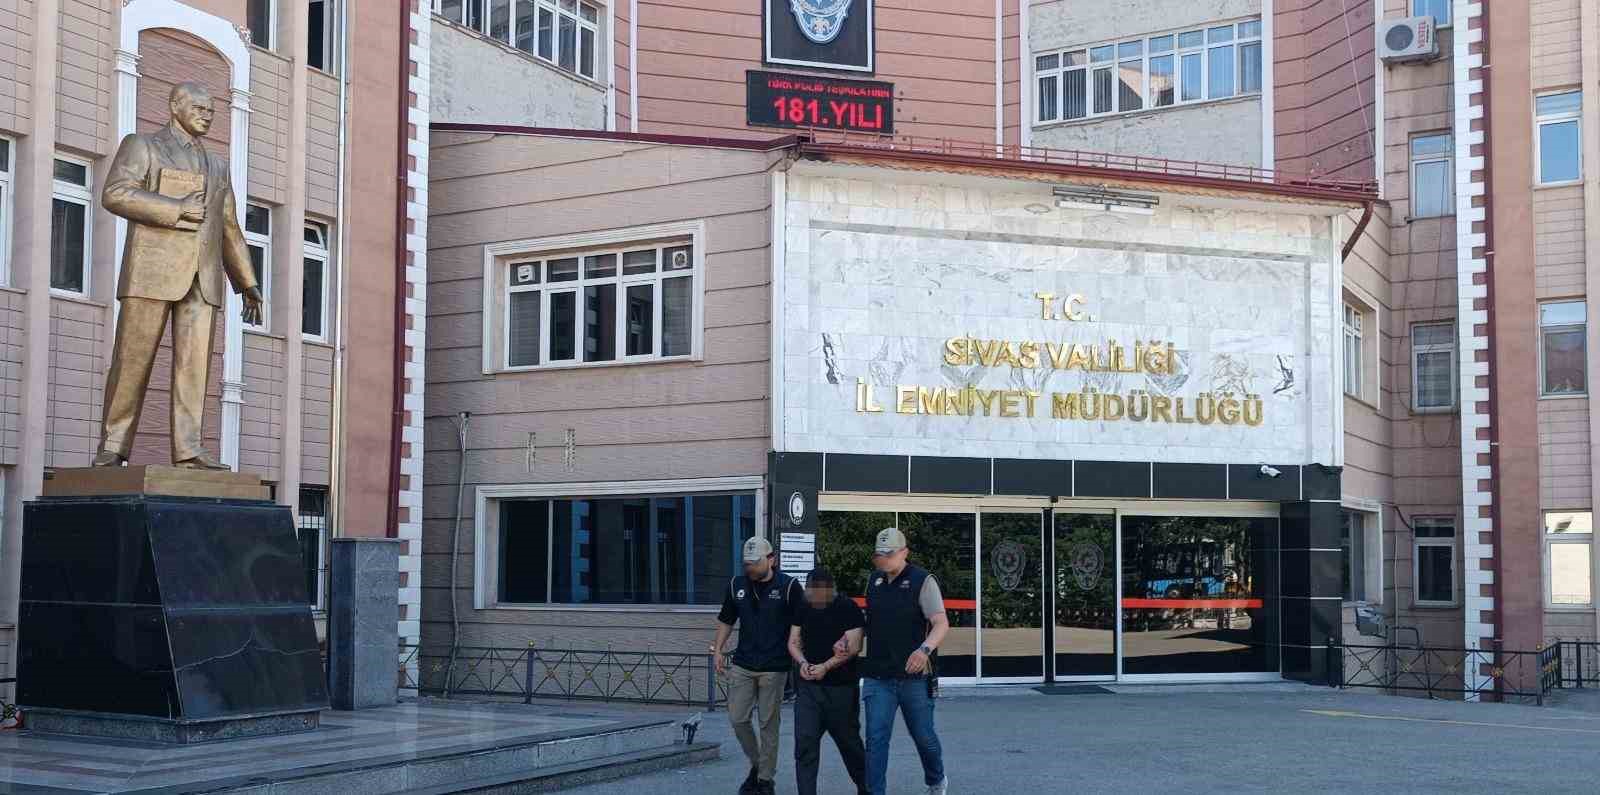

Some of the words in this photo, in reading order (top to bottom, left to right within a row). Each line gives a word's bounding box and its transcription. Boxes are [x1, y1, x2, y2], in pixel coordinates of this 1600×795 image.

[774, 96, 883, 129] 181.YILI
[1036, 292, 1096, 321] T.C.
[944, 333, 1040, 368] SİVAS
[856, 376, 882, 413] İL
[896, 384, 1040, 418] EMNİYET
[1052, 387, 1264, 426] MÜDÜRLÜĞÜ
